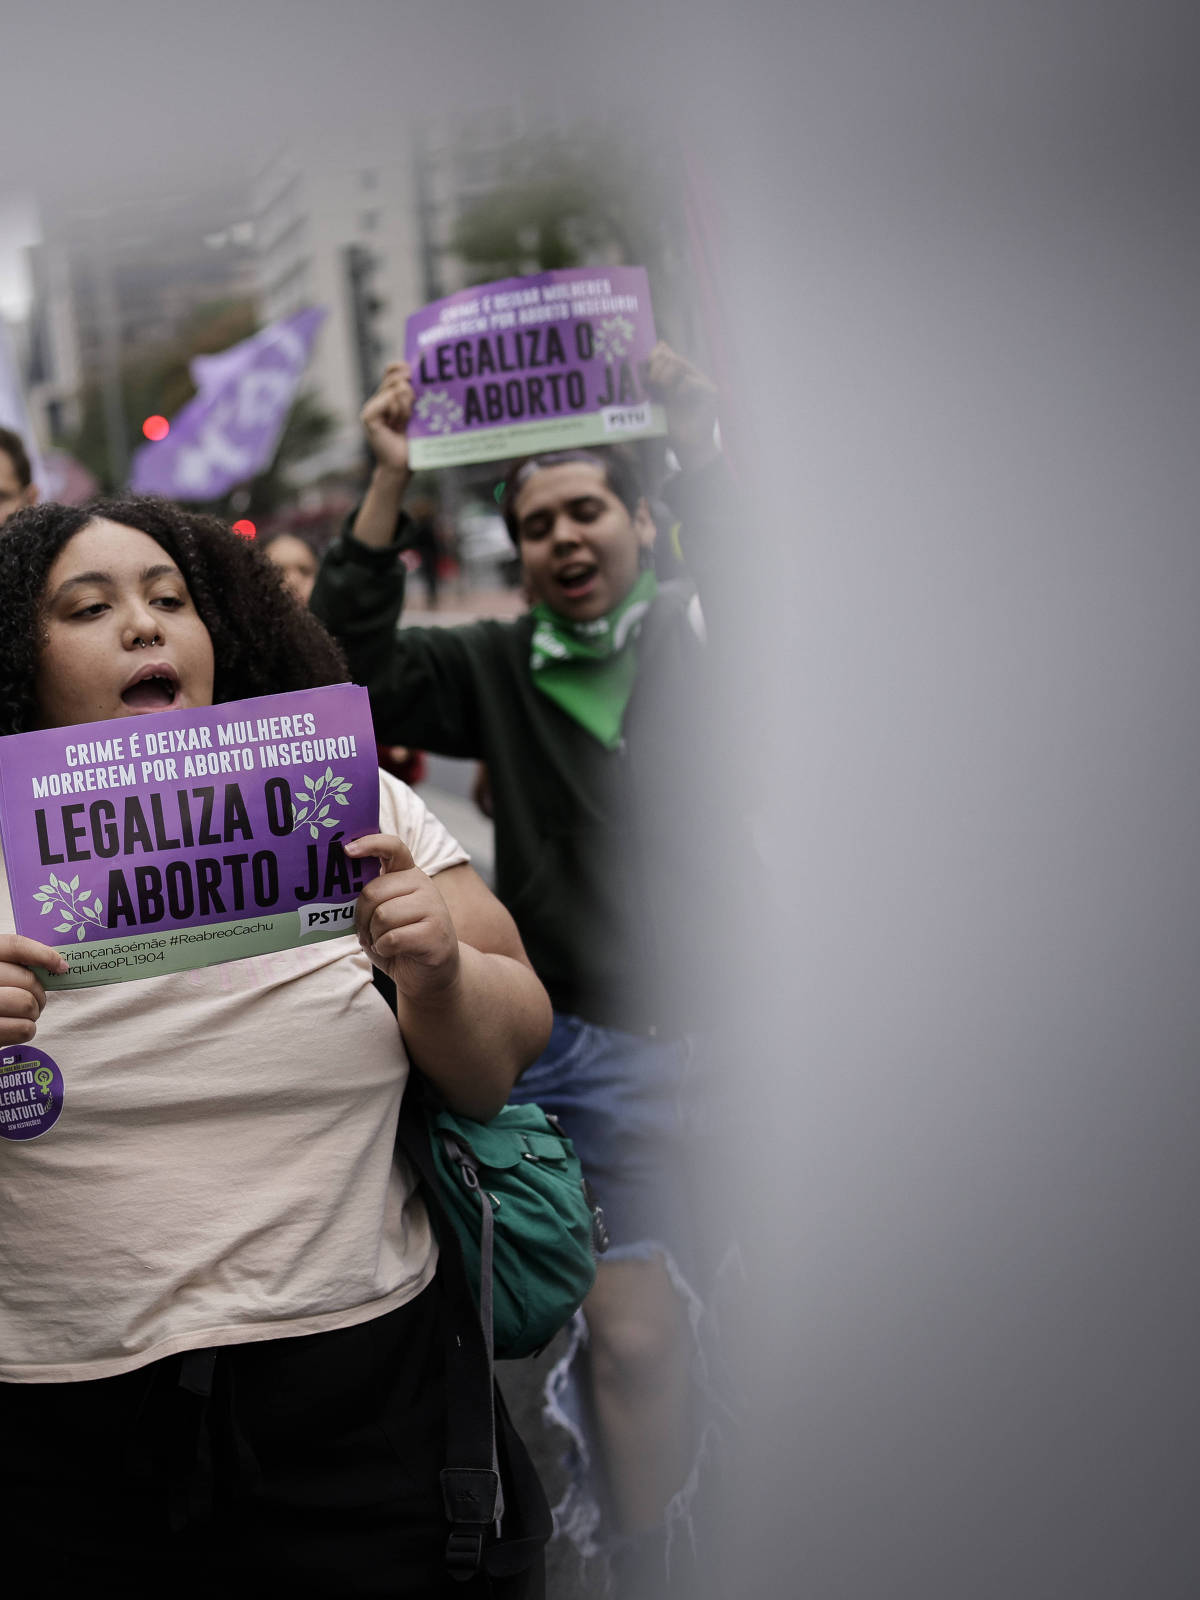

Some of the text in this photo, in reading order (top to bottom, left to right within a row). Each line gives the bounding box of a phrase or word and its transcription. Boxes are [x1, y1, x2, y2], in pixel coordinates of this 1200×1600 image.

[418, 321, 595, 386] LEGALIZA O
[464, 369, 588, 427] ABORTO
[32, 735, 358, 799] MORREREM POR ABORTO INSEGURO!
[65, 712, 316, 767] CRIME É DEIXAR MULHERES
[34, 776, 294, 866] LEGALIZA O
[107, 831, 364, 929] ABORTO JÁ!
[169, 920, 274, 947] #ReabreoCachu
[308, 905, 354, 927] PSTU
[48, 950, 165, 977] rquivaoPL1904
[30, 1086, 37, 1100] E
